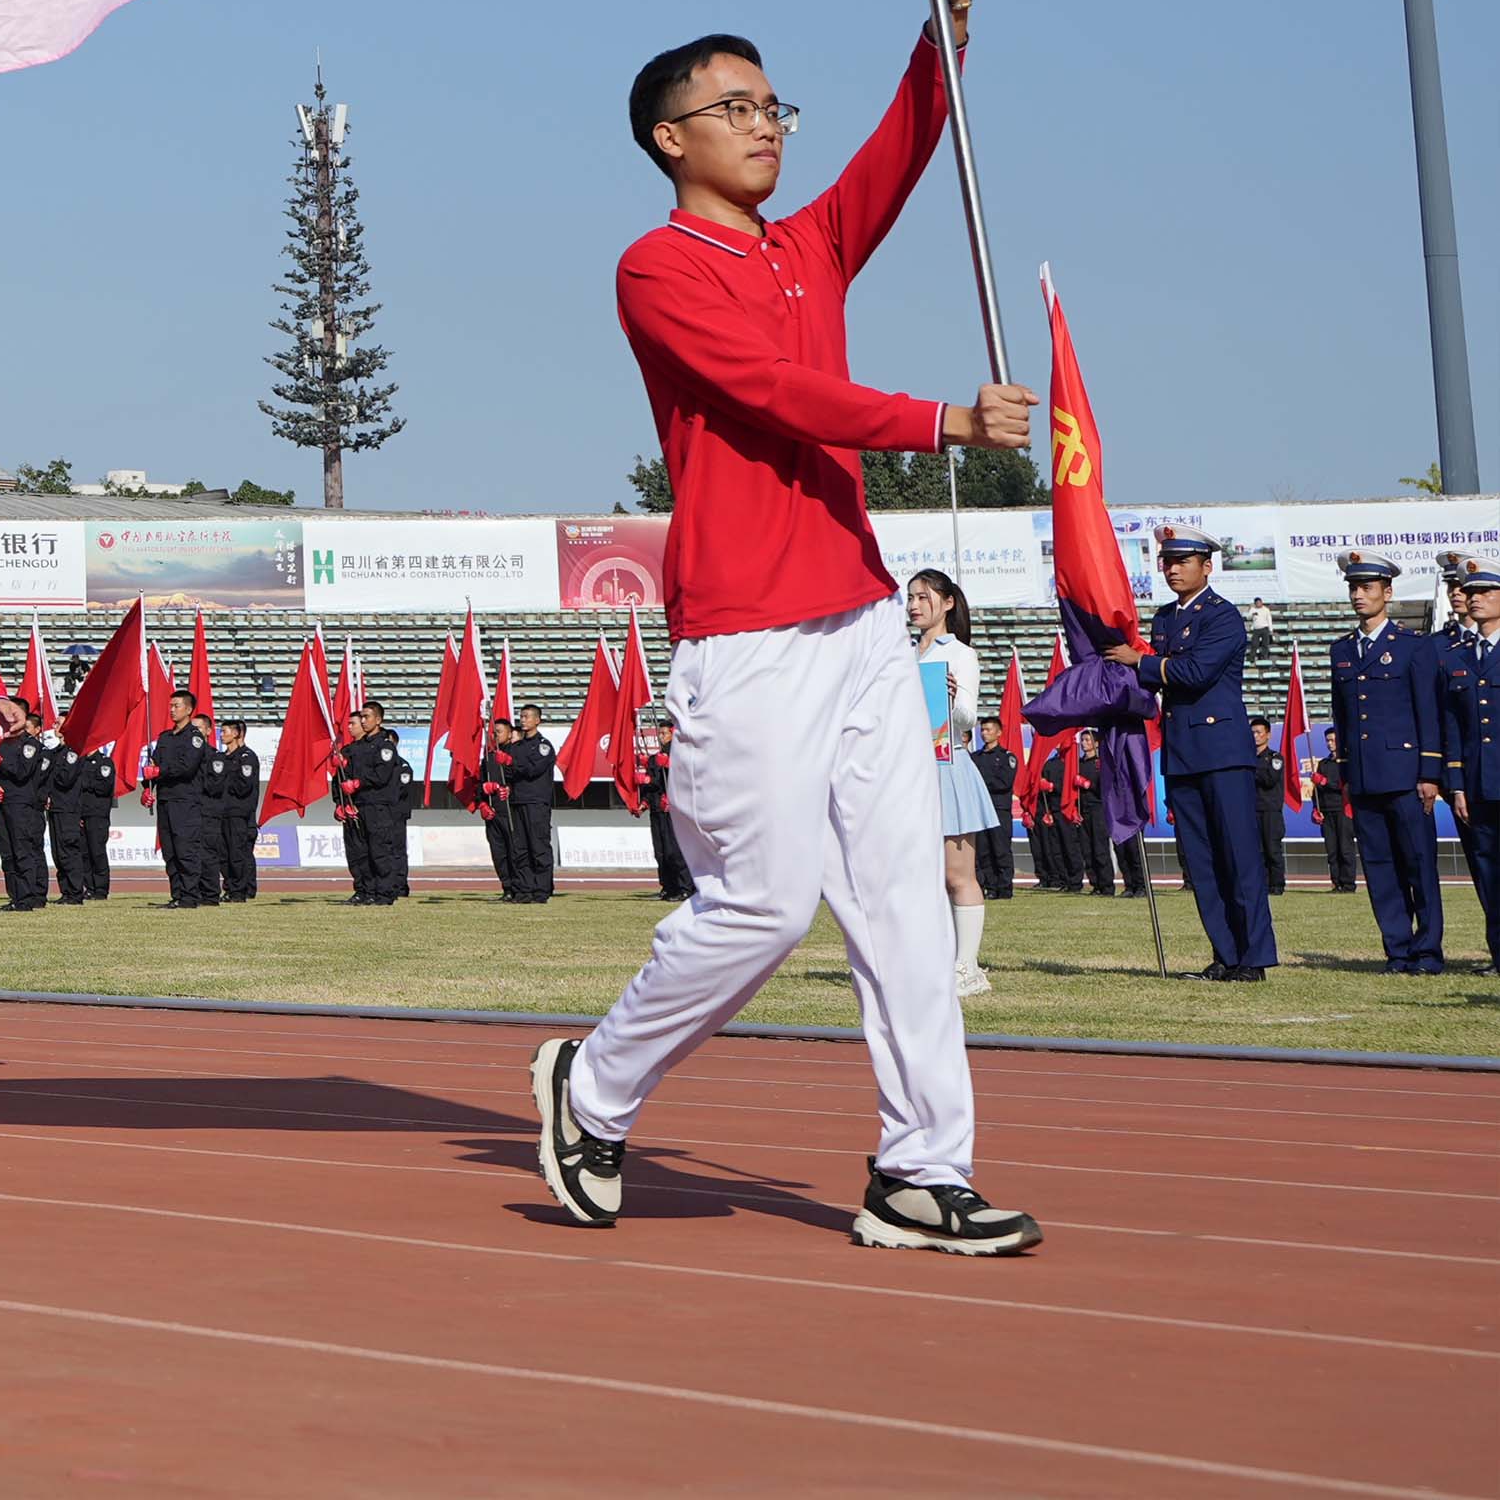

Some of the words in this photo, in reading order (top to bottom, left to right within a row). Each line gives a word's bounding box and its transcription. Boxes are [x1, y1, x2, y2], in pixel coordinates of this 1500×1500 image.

[341, 554, 524, 571] 四川省第四建筑有限公司
[341, 571, 383, 579] SICHUAN
[410, 571, 485, 579] CONSTRUCTION
